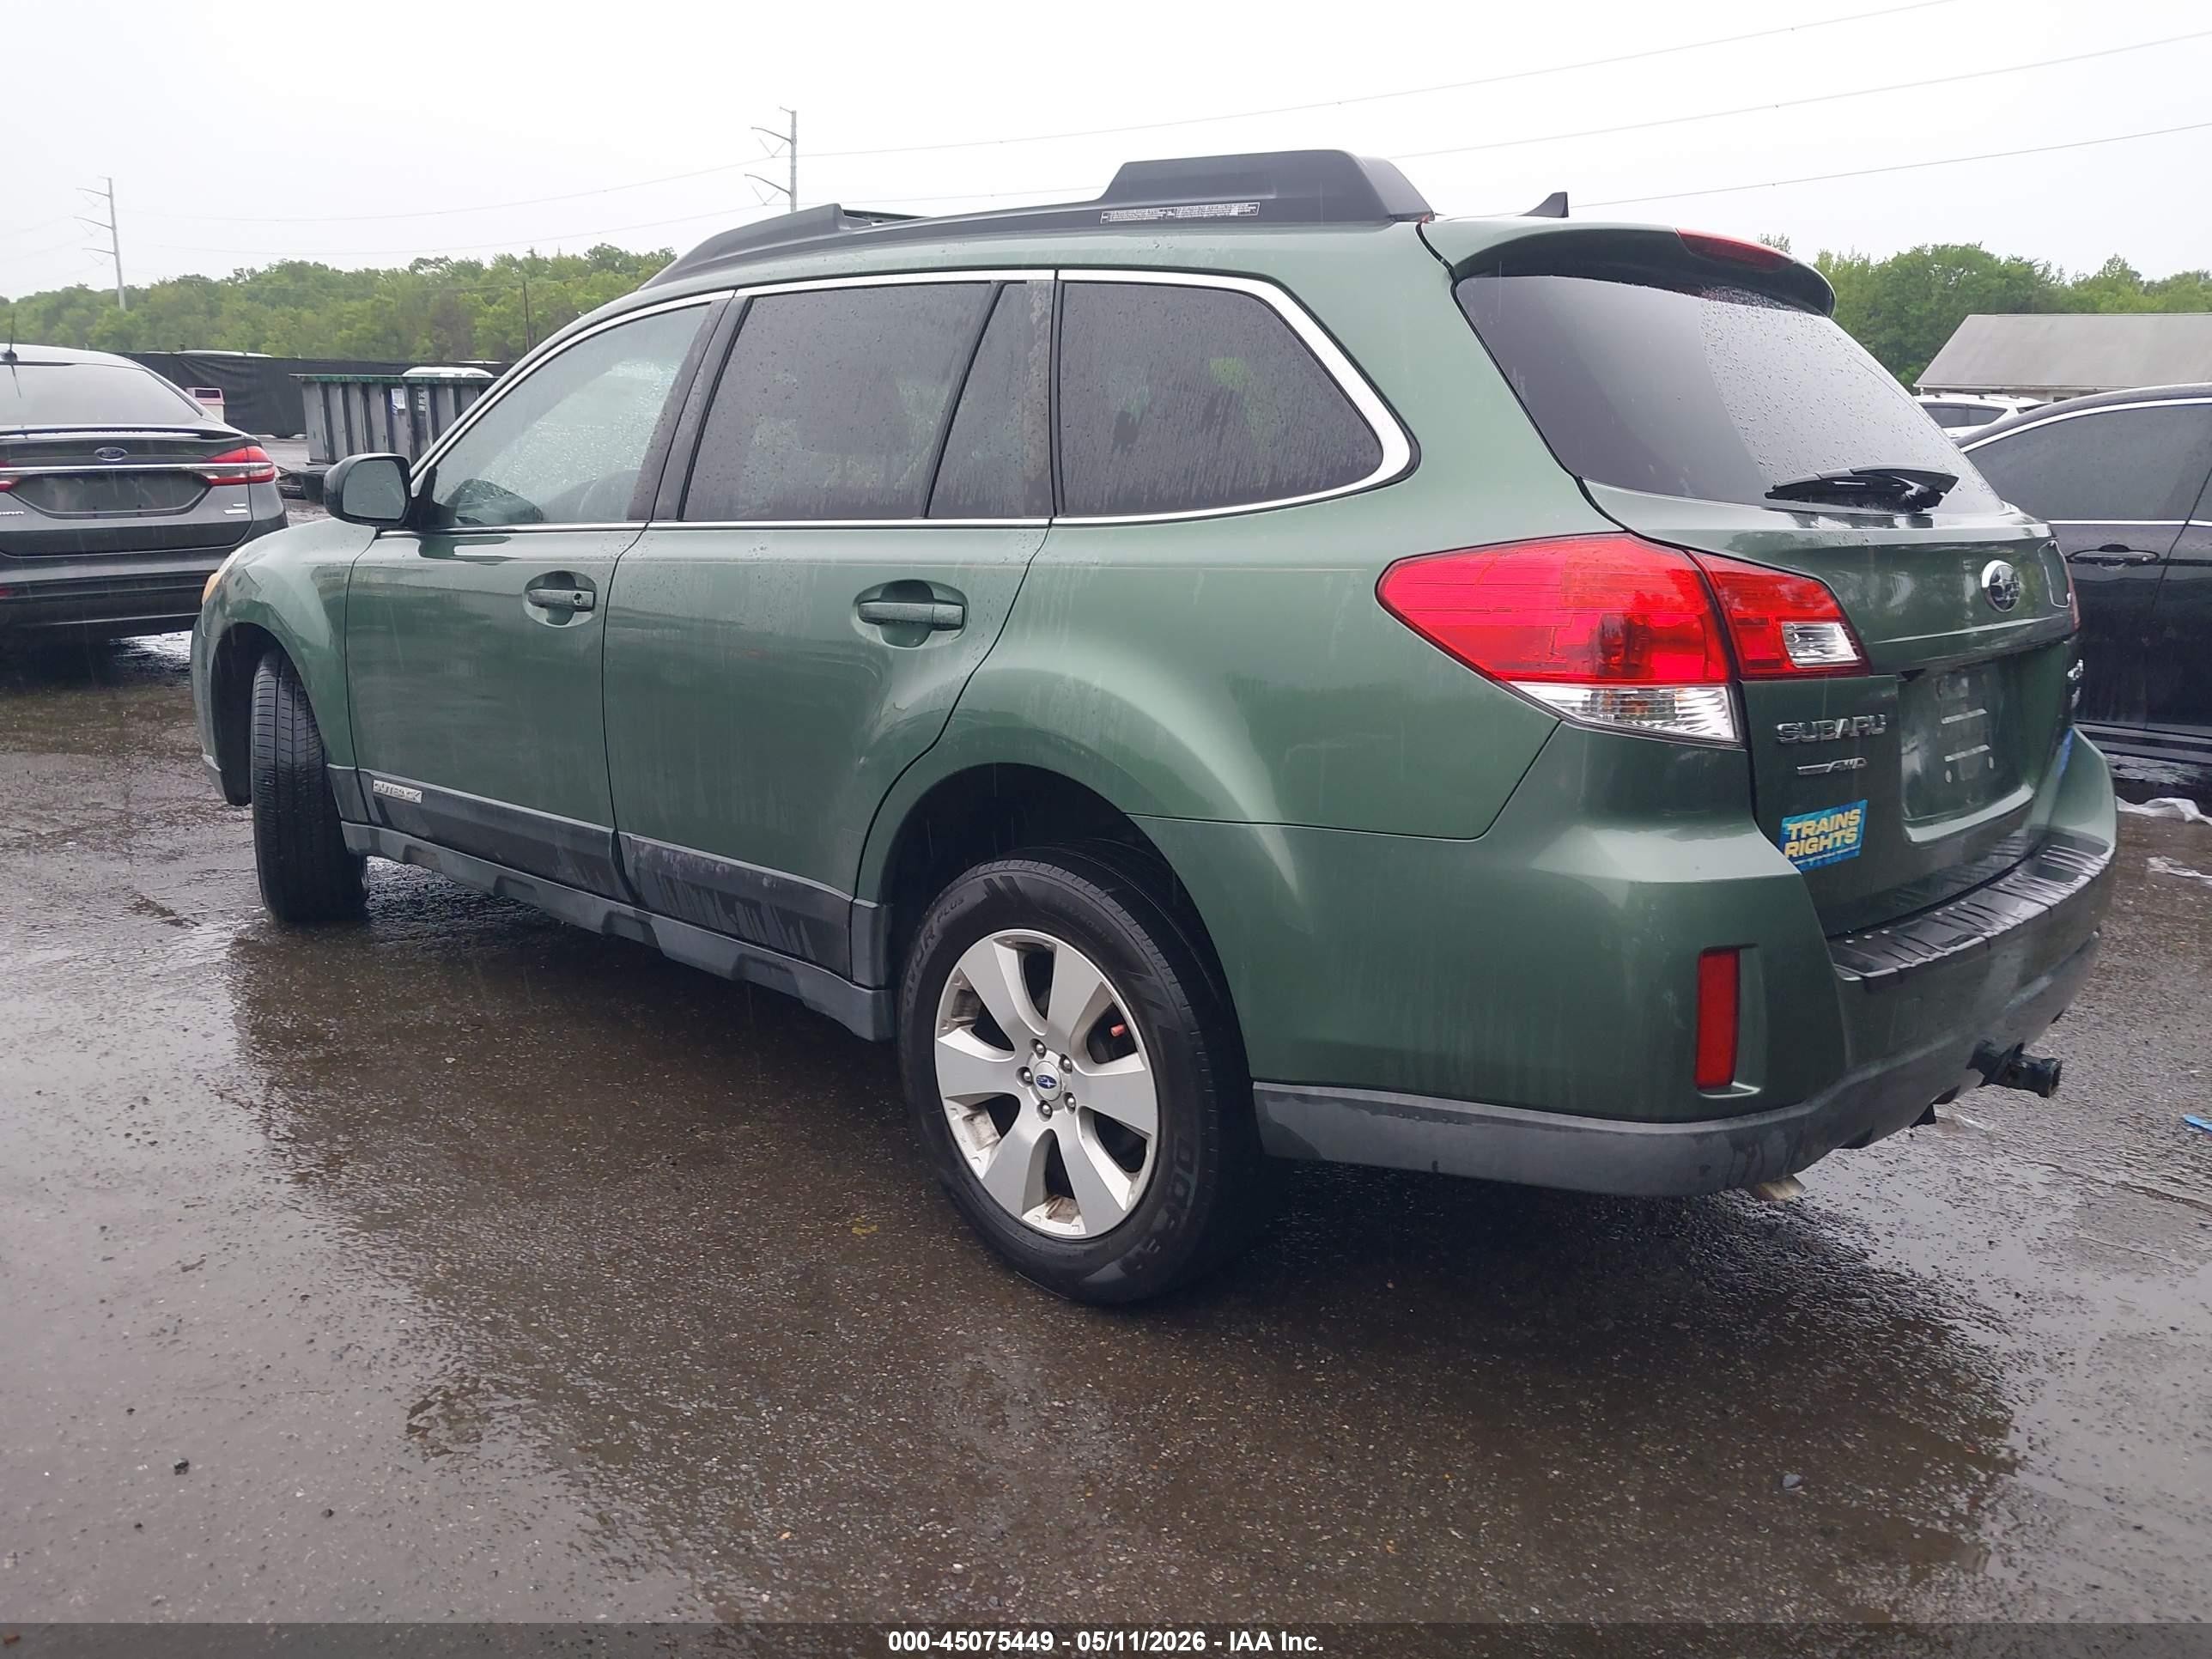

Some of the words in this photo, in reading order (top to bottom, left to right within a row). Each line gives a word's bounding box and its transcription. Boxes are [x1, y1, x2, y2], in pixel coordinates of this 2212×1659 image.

[1776, 714, 1887, 744] SUBARU
[1787, 808, 1862, 841] TRAINS
[1784, 826, 1859, 859] RIGHTS
